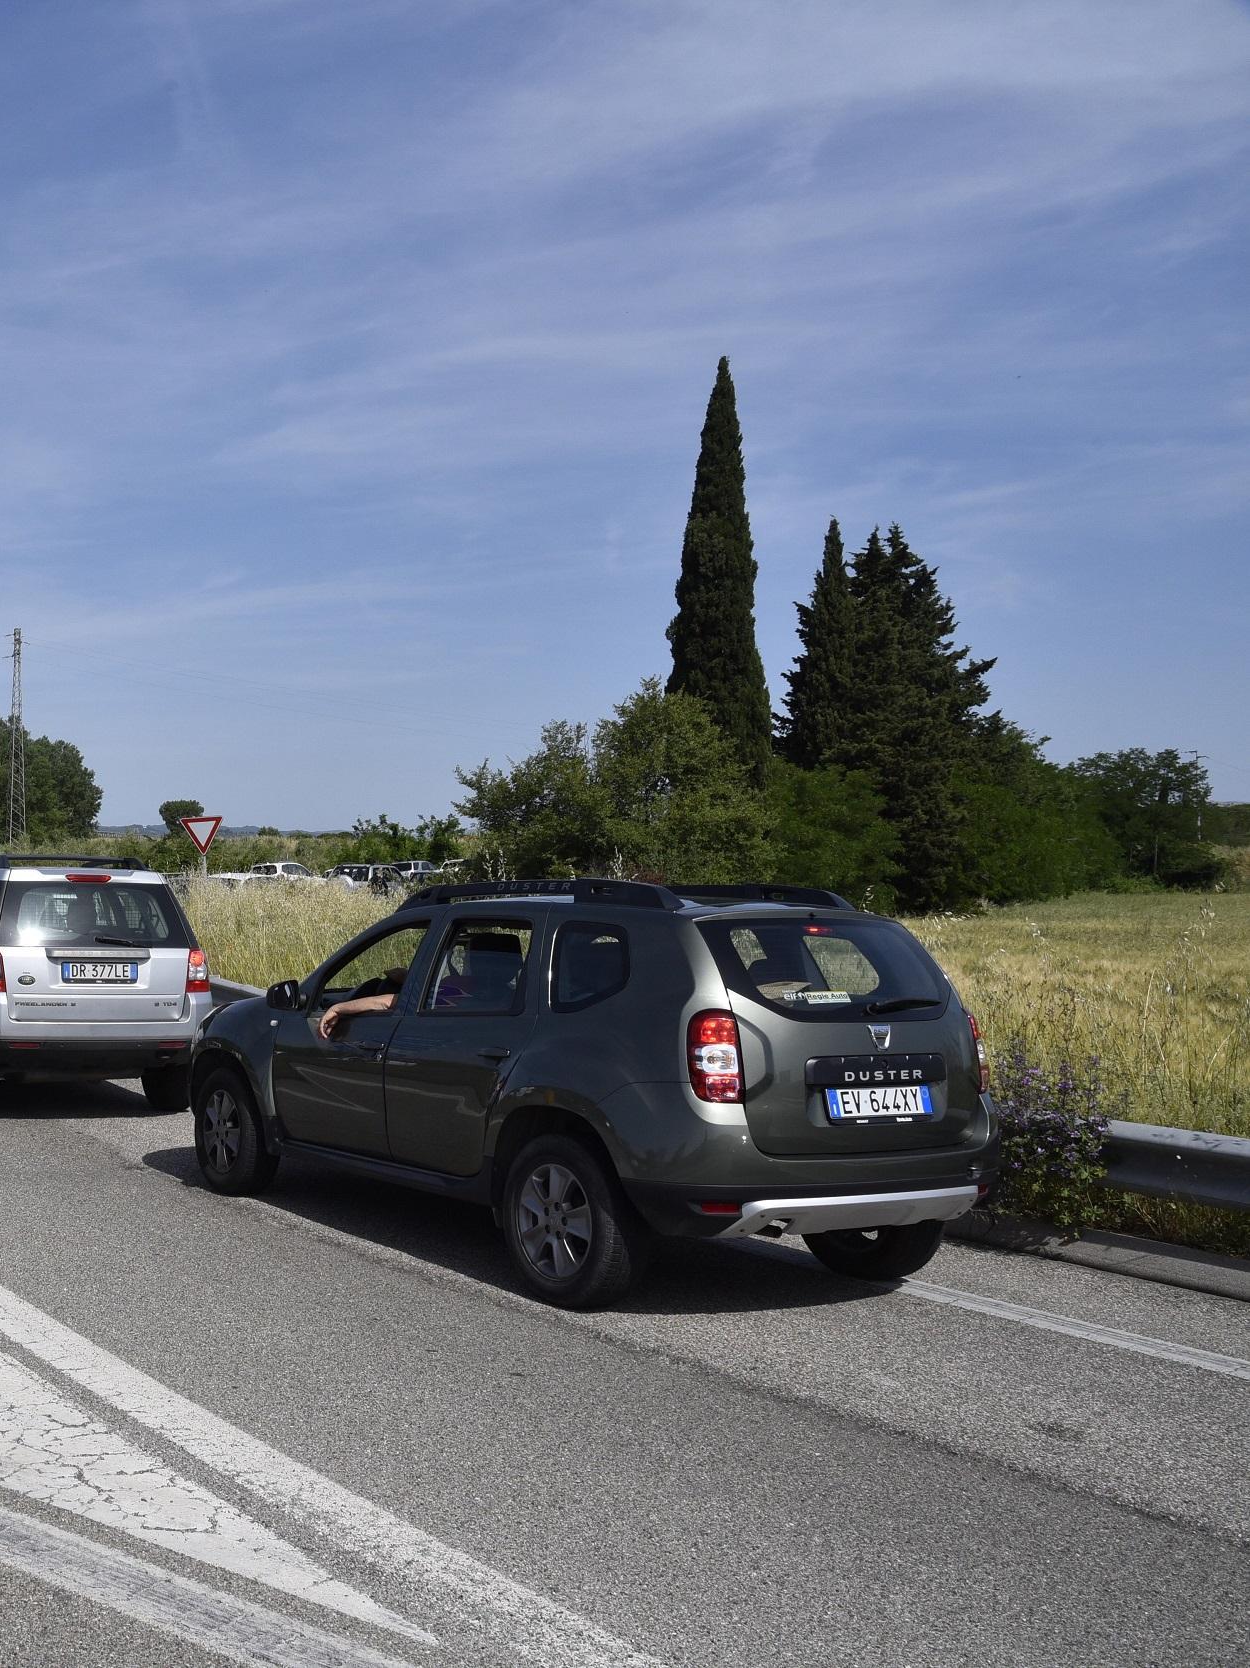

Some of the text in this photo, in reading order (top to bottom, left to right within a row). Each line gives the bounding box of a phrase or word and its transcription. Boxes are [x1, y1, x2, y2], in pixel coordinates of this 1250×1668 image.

[497, 882, 571, 891] DUSTER
[71, 964, 87, 978] DR
[91, 964, 130, 978] 377LE
[844, 1069, 923, 1082] DUSTER
[840, 1090, 861, 1114] EV
[869, 1088, 920, 1112] 644XY
